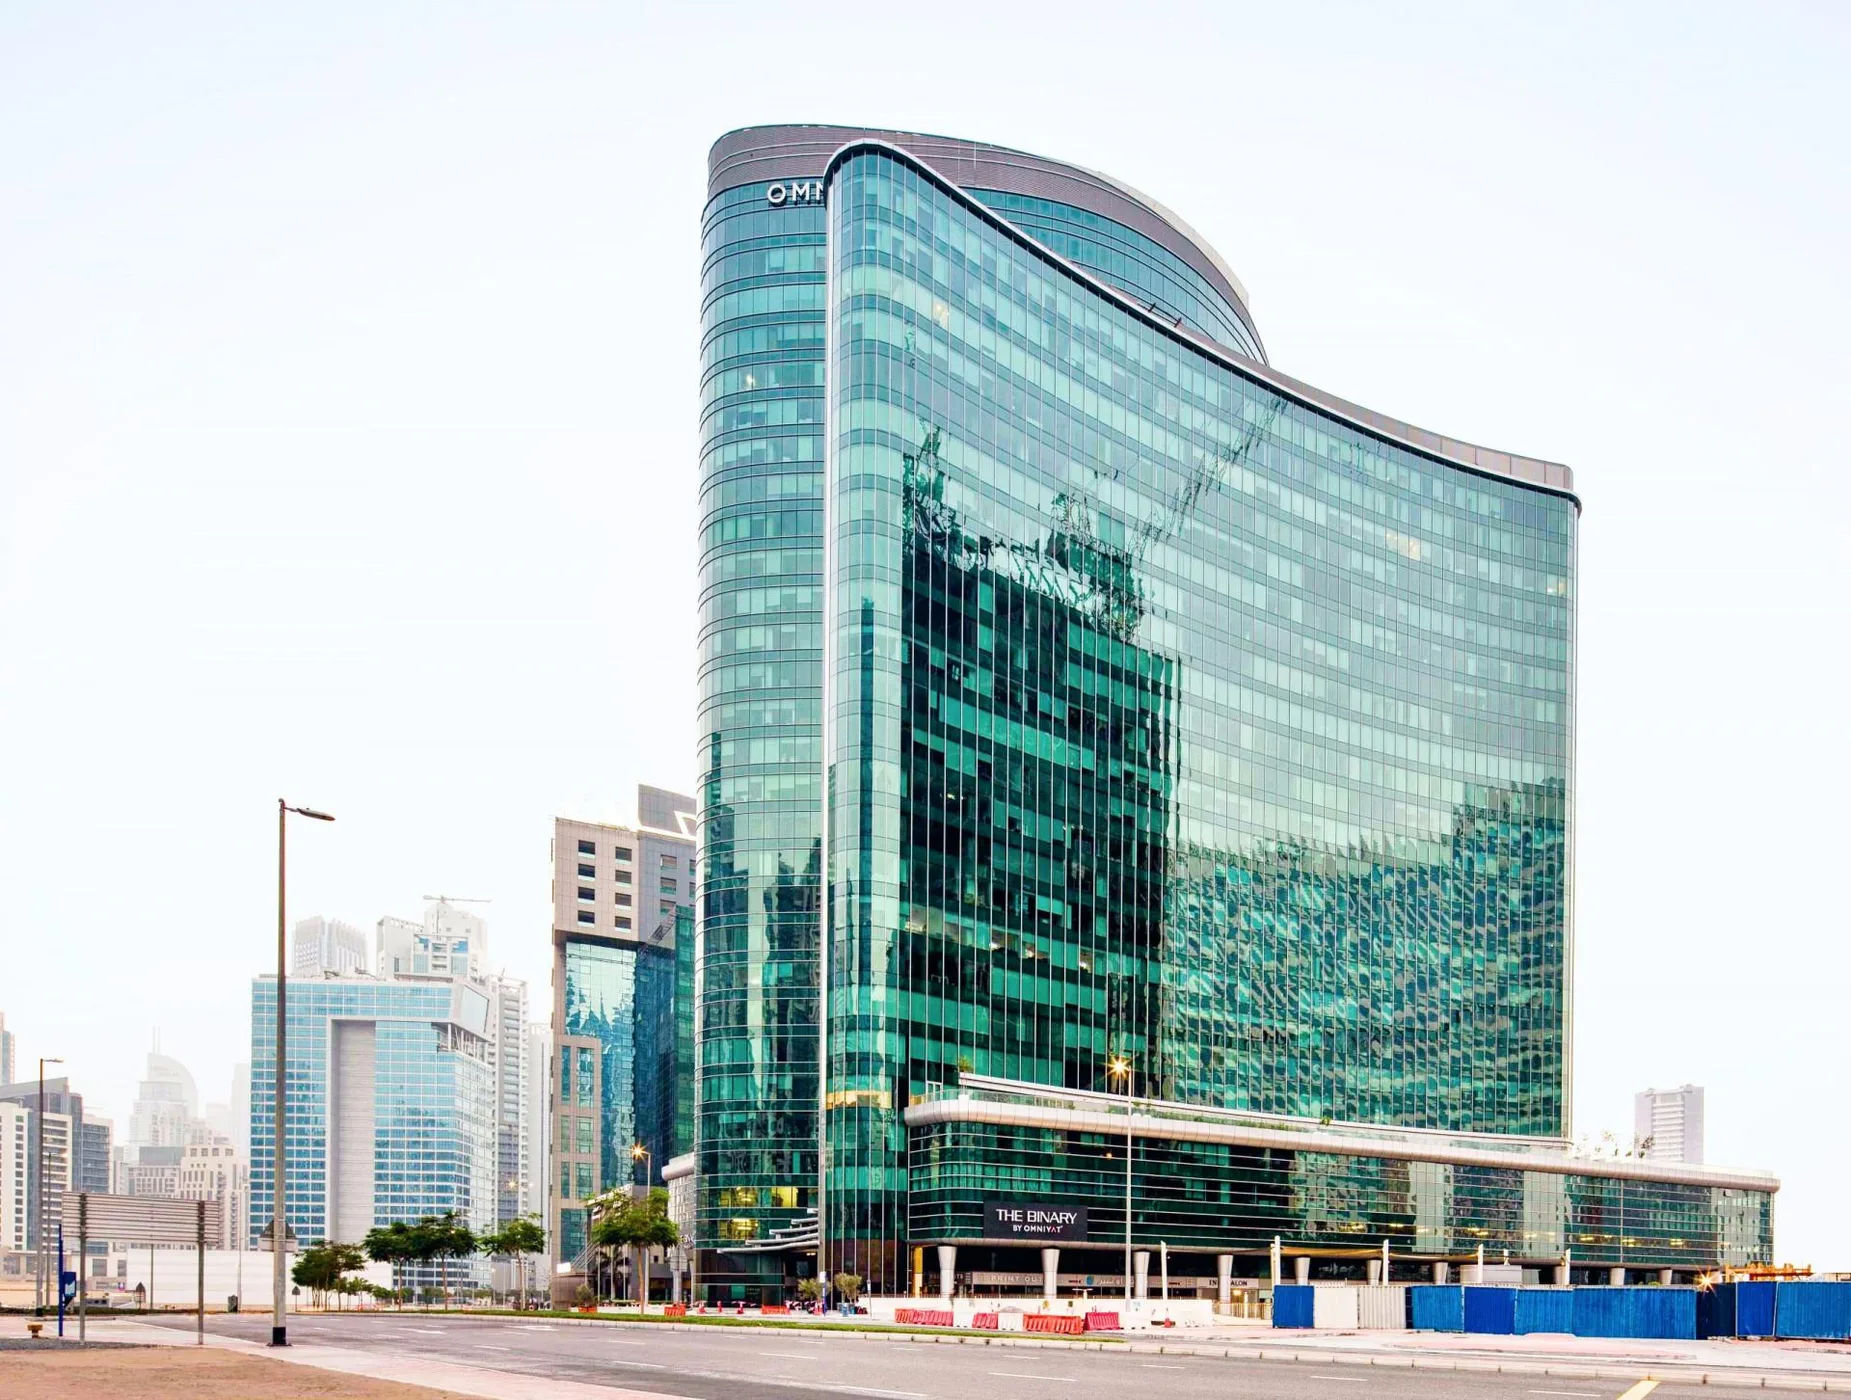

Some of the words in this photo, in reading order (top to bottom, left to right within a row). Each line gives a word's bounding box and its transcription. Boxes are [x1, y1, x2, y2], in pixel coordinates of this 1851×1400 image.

[995, 1208, 1023, 1222] THE
[1027, 1210, 1078, 1225] BINARY
[1012, 1224, 1021, 1232] BY
[1023, 1225, 1061, 1234] OMNIYAT
